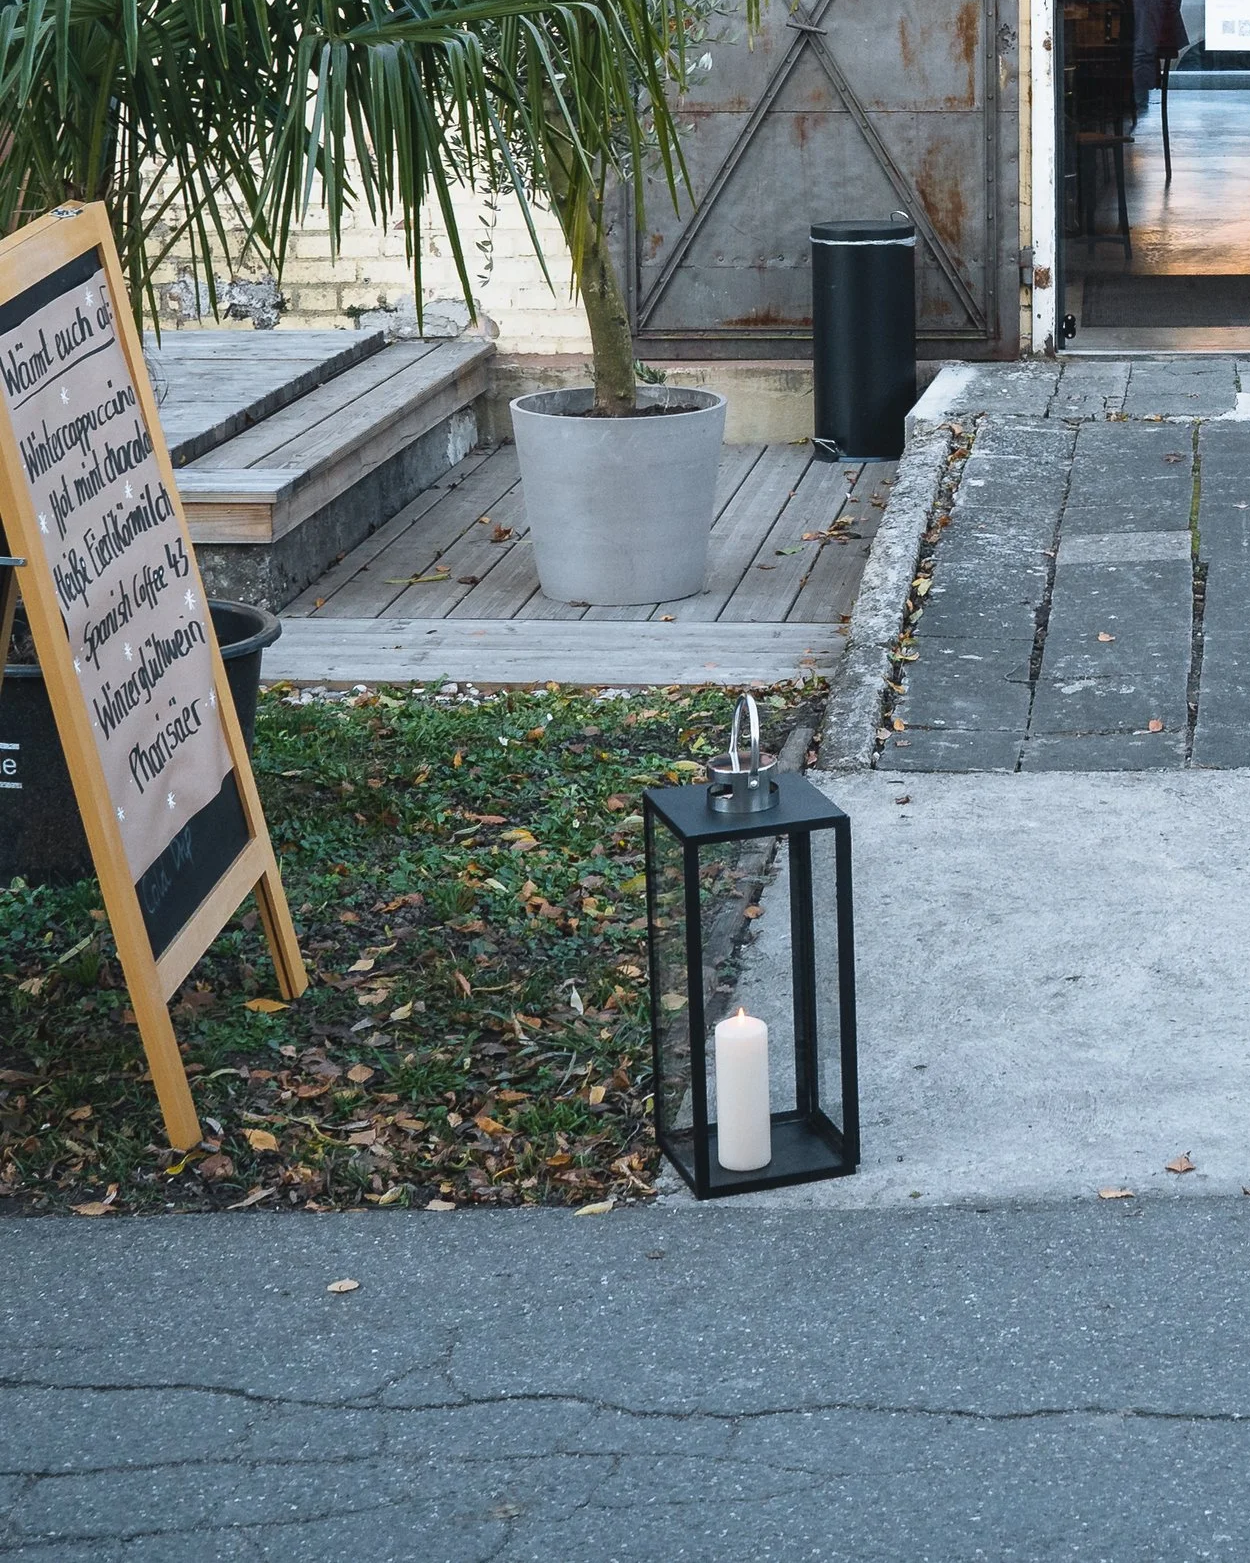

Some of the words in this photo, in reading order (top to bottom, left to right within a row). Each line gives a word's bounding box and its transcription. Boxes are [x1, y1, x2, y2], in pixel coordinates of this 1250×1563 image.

[54, 306, 94, 361] euch
[49, 474, 75, 542] Hot
[73, 449, 106, 506] mint
